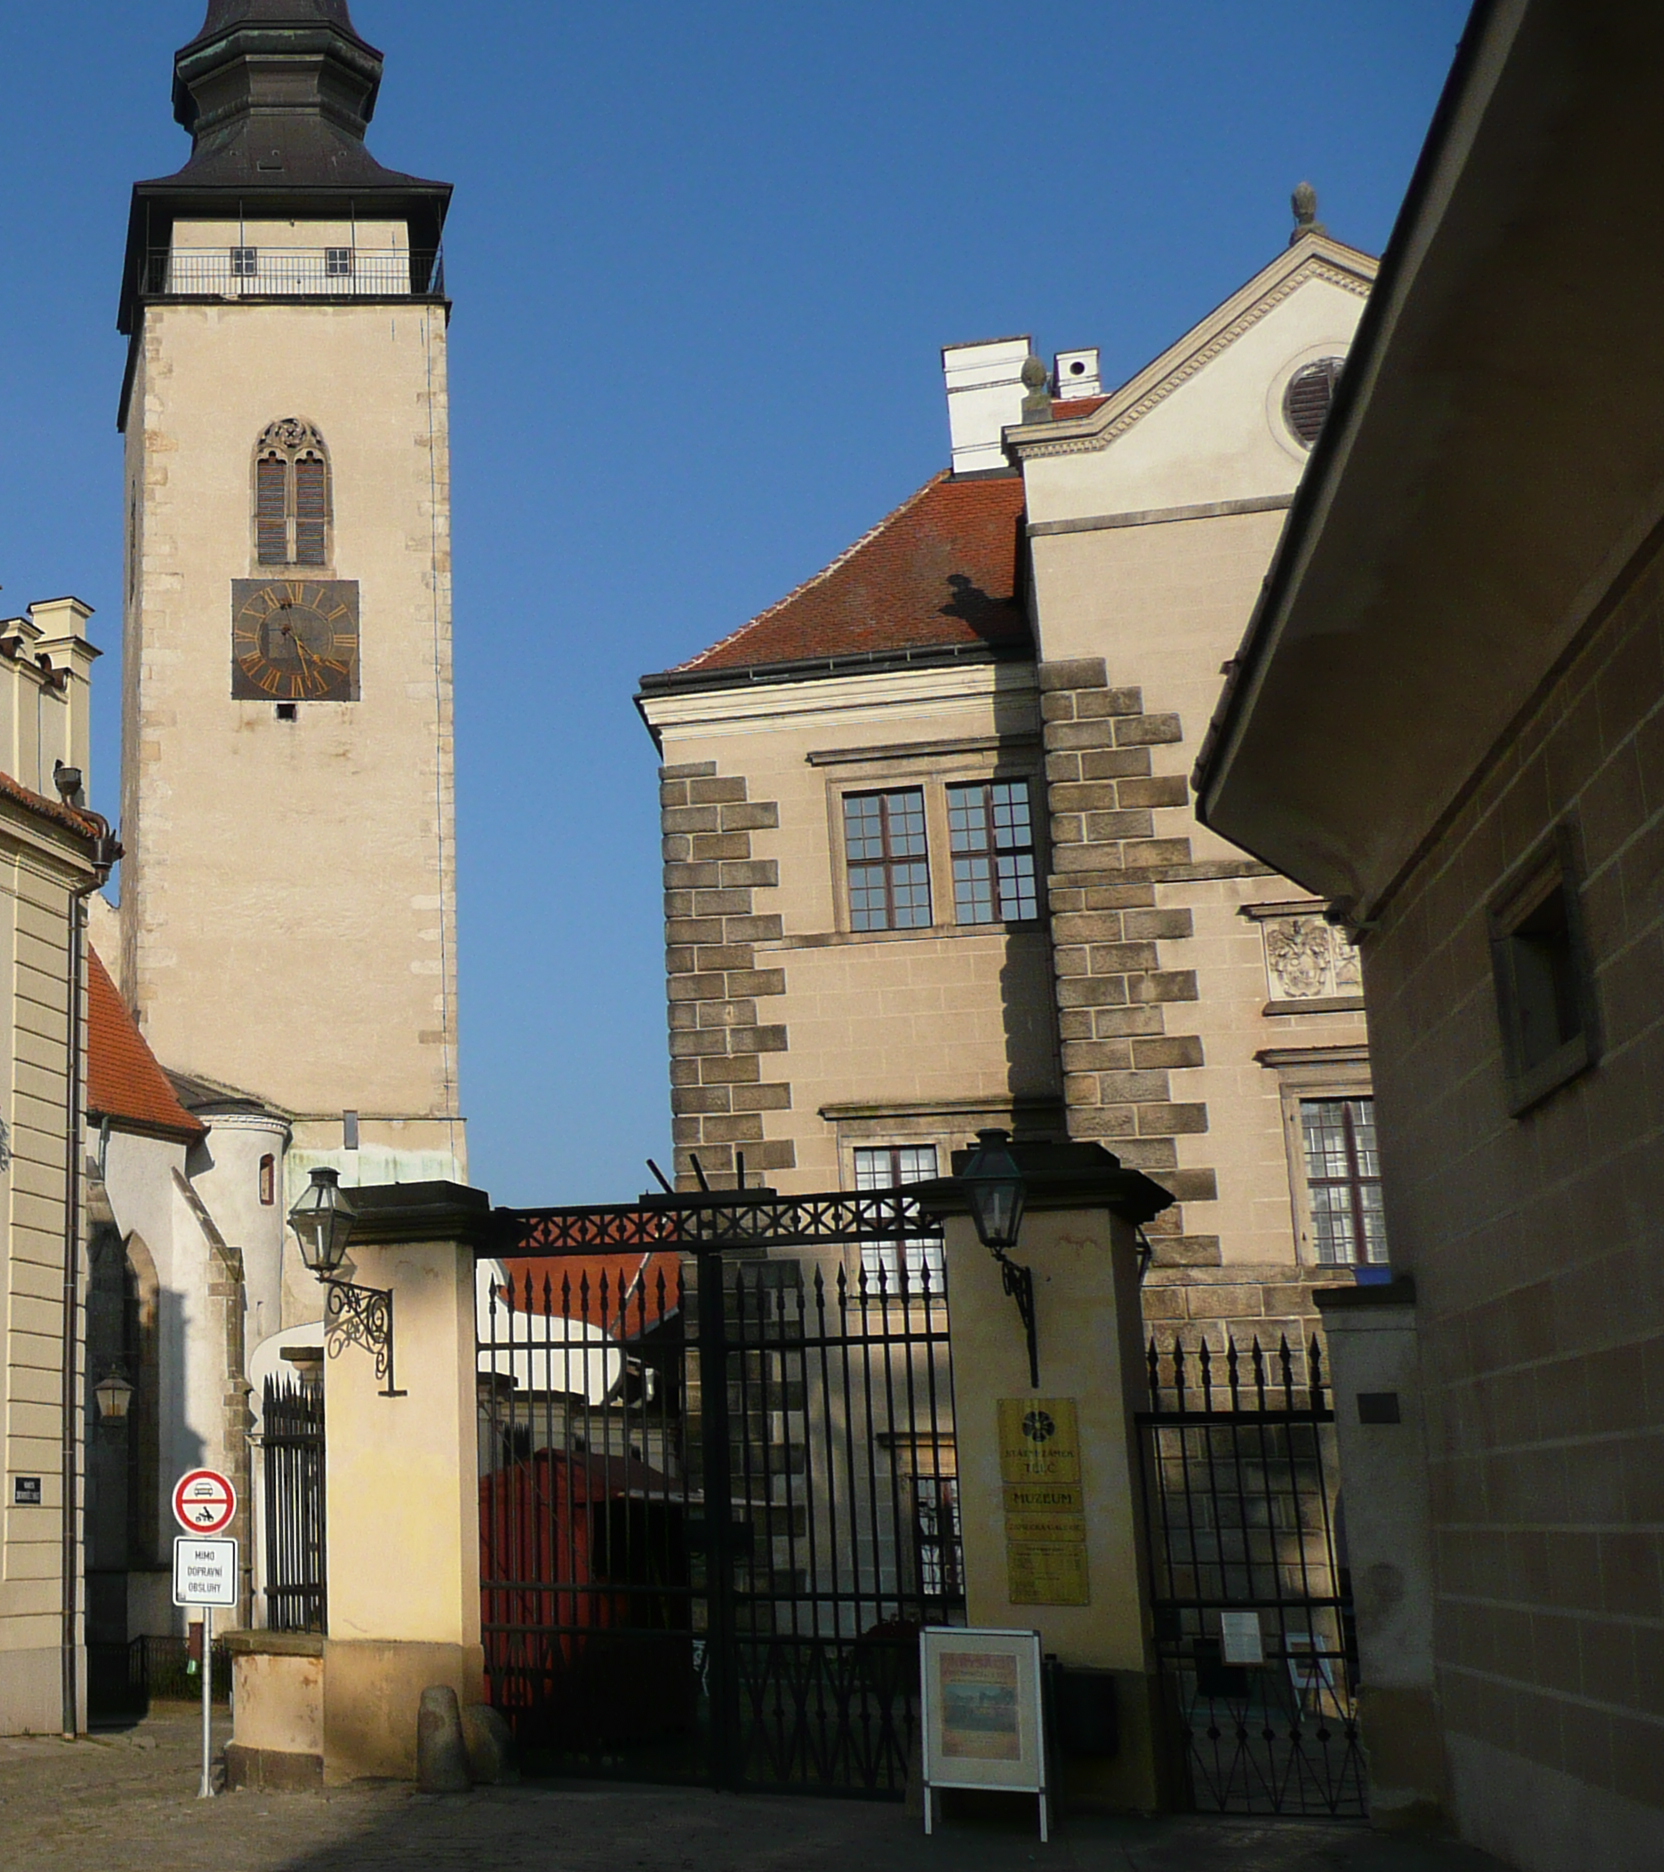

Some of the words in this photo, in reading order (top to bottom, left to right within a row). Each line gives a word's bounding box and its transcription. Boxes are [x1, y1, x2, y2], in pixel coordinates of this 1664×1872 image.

[1013, 1493, 1073, 1505] MUZEUM
[194, 1550, 215, 1561] MIMO
[187, 1565, 223, 1578] DOPRAVNÍ
[188, 1582, 222, 1593] OBSLUHY
